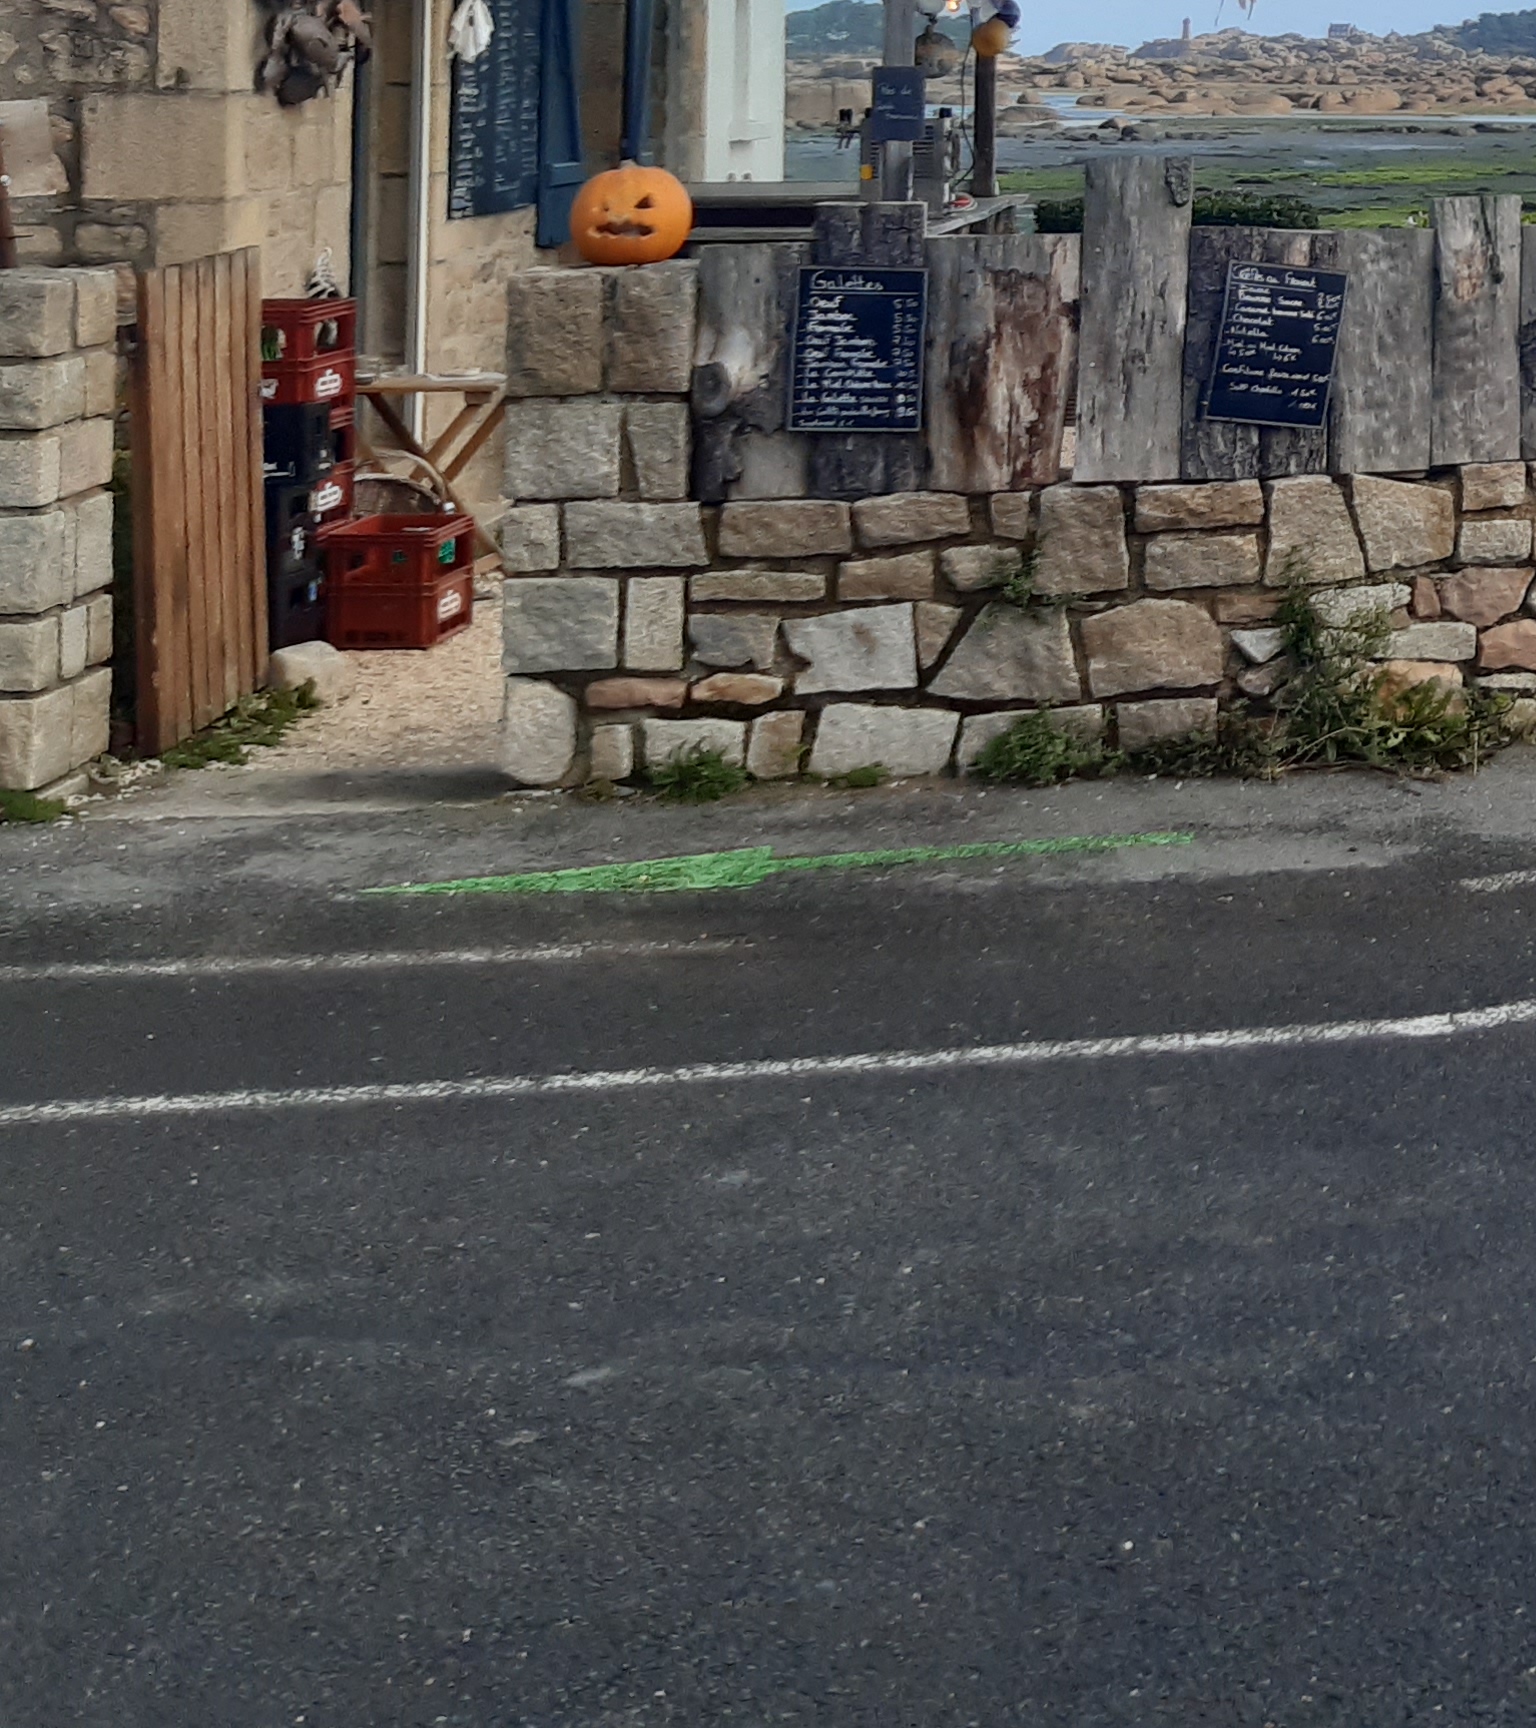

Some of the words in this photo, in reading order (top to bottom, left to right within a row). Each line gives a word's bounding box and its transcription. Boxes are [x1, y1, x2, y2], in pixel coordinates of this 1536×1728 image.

[809, 270, 884, 290] Galettes
[1232, 313, 1275, 326] Chocolat
[1230, 325, 1269, 338] Nutella
